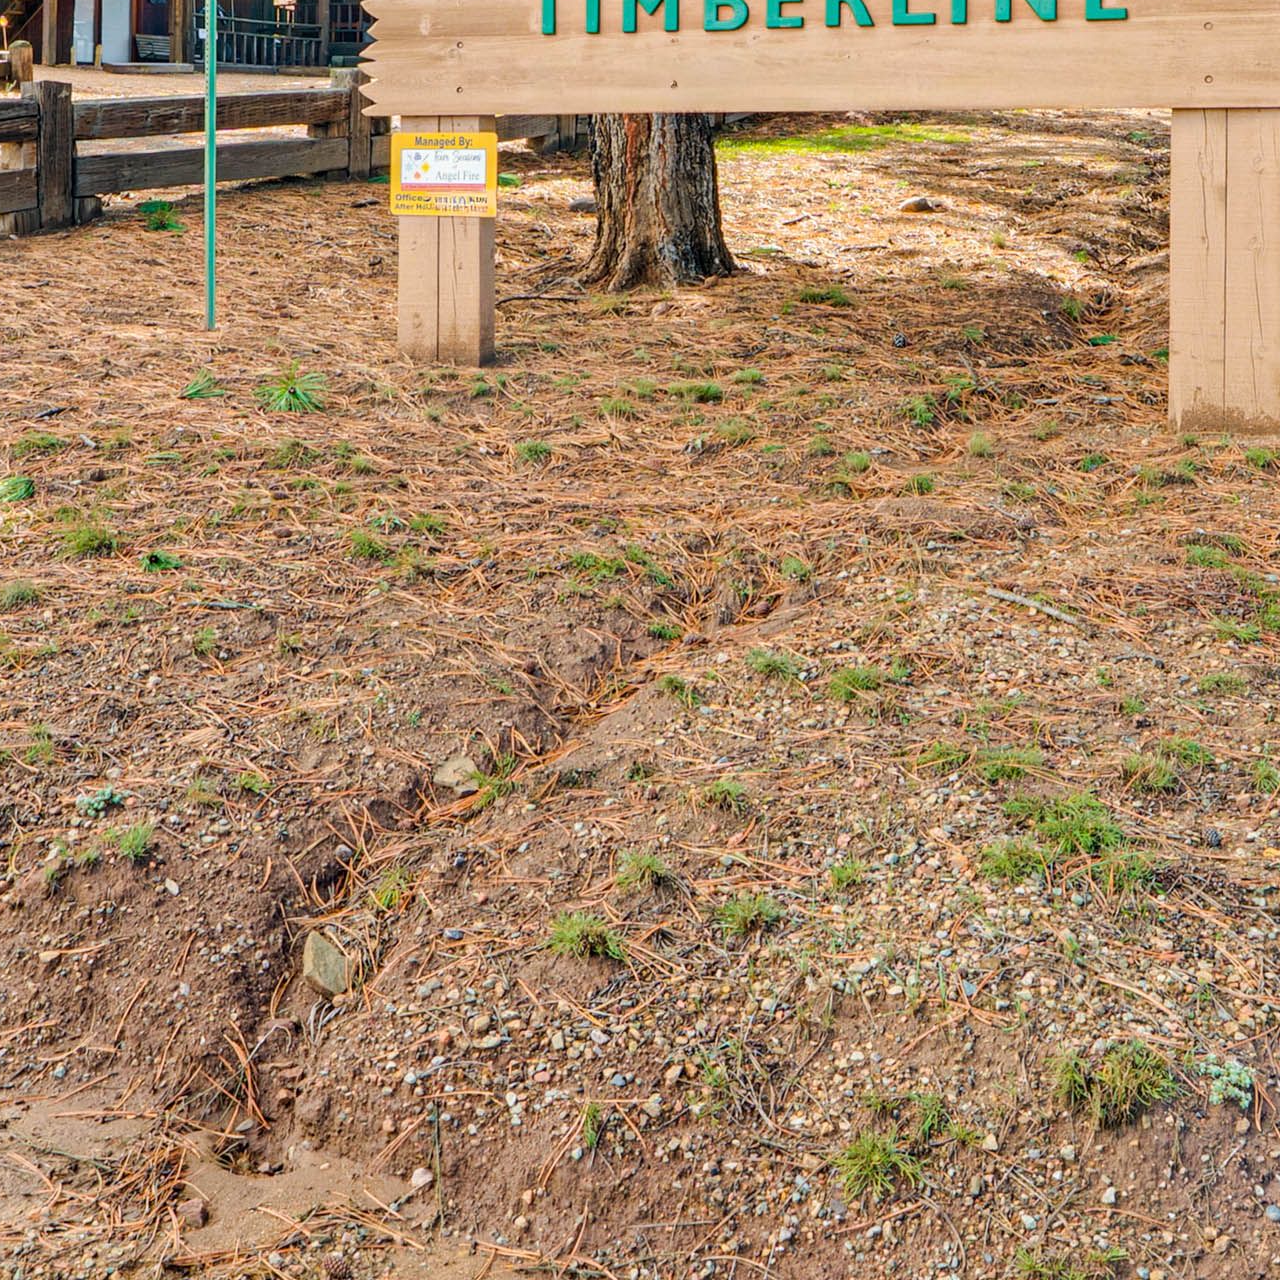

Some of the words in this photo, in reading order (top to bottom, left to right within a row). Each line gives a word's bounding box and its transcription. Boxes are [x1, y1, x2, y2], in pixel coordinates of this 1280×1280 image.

[415, 136, 456, 148] Managed
[435, 171, 461, 182] Angel
[463, 171, 480, 181] Fire
